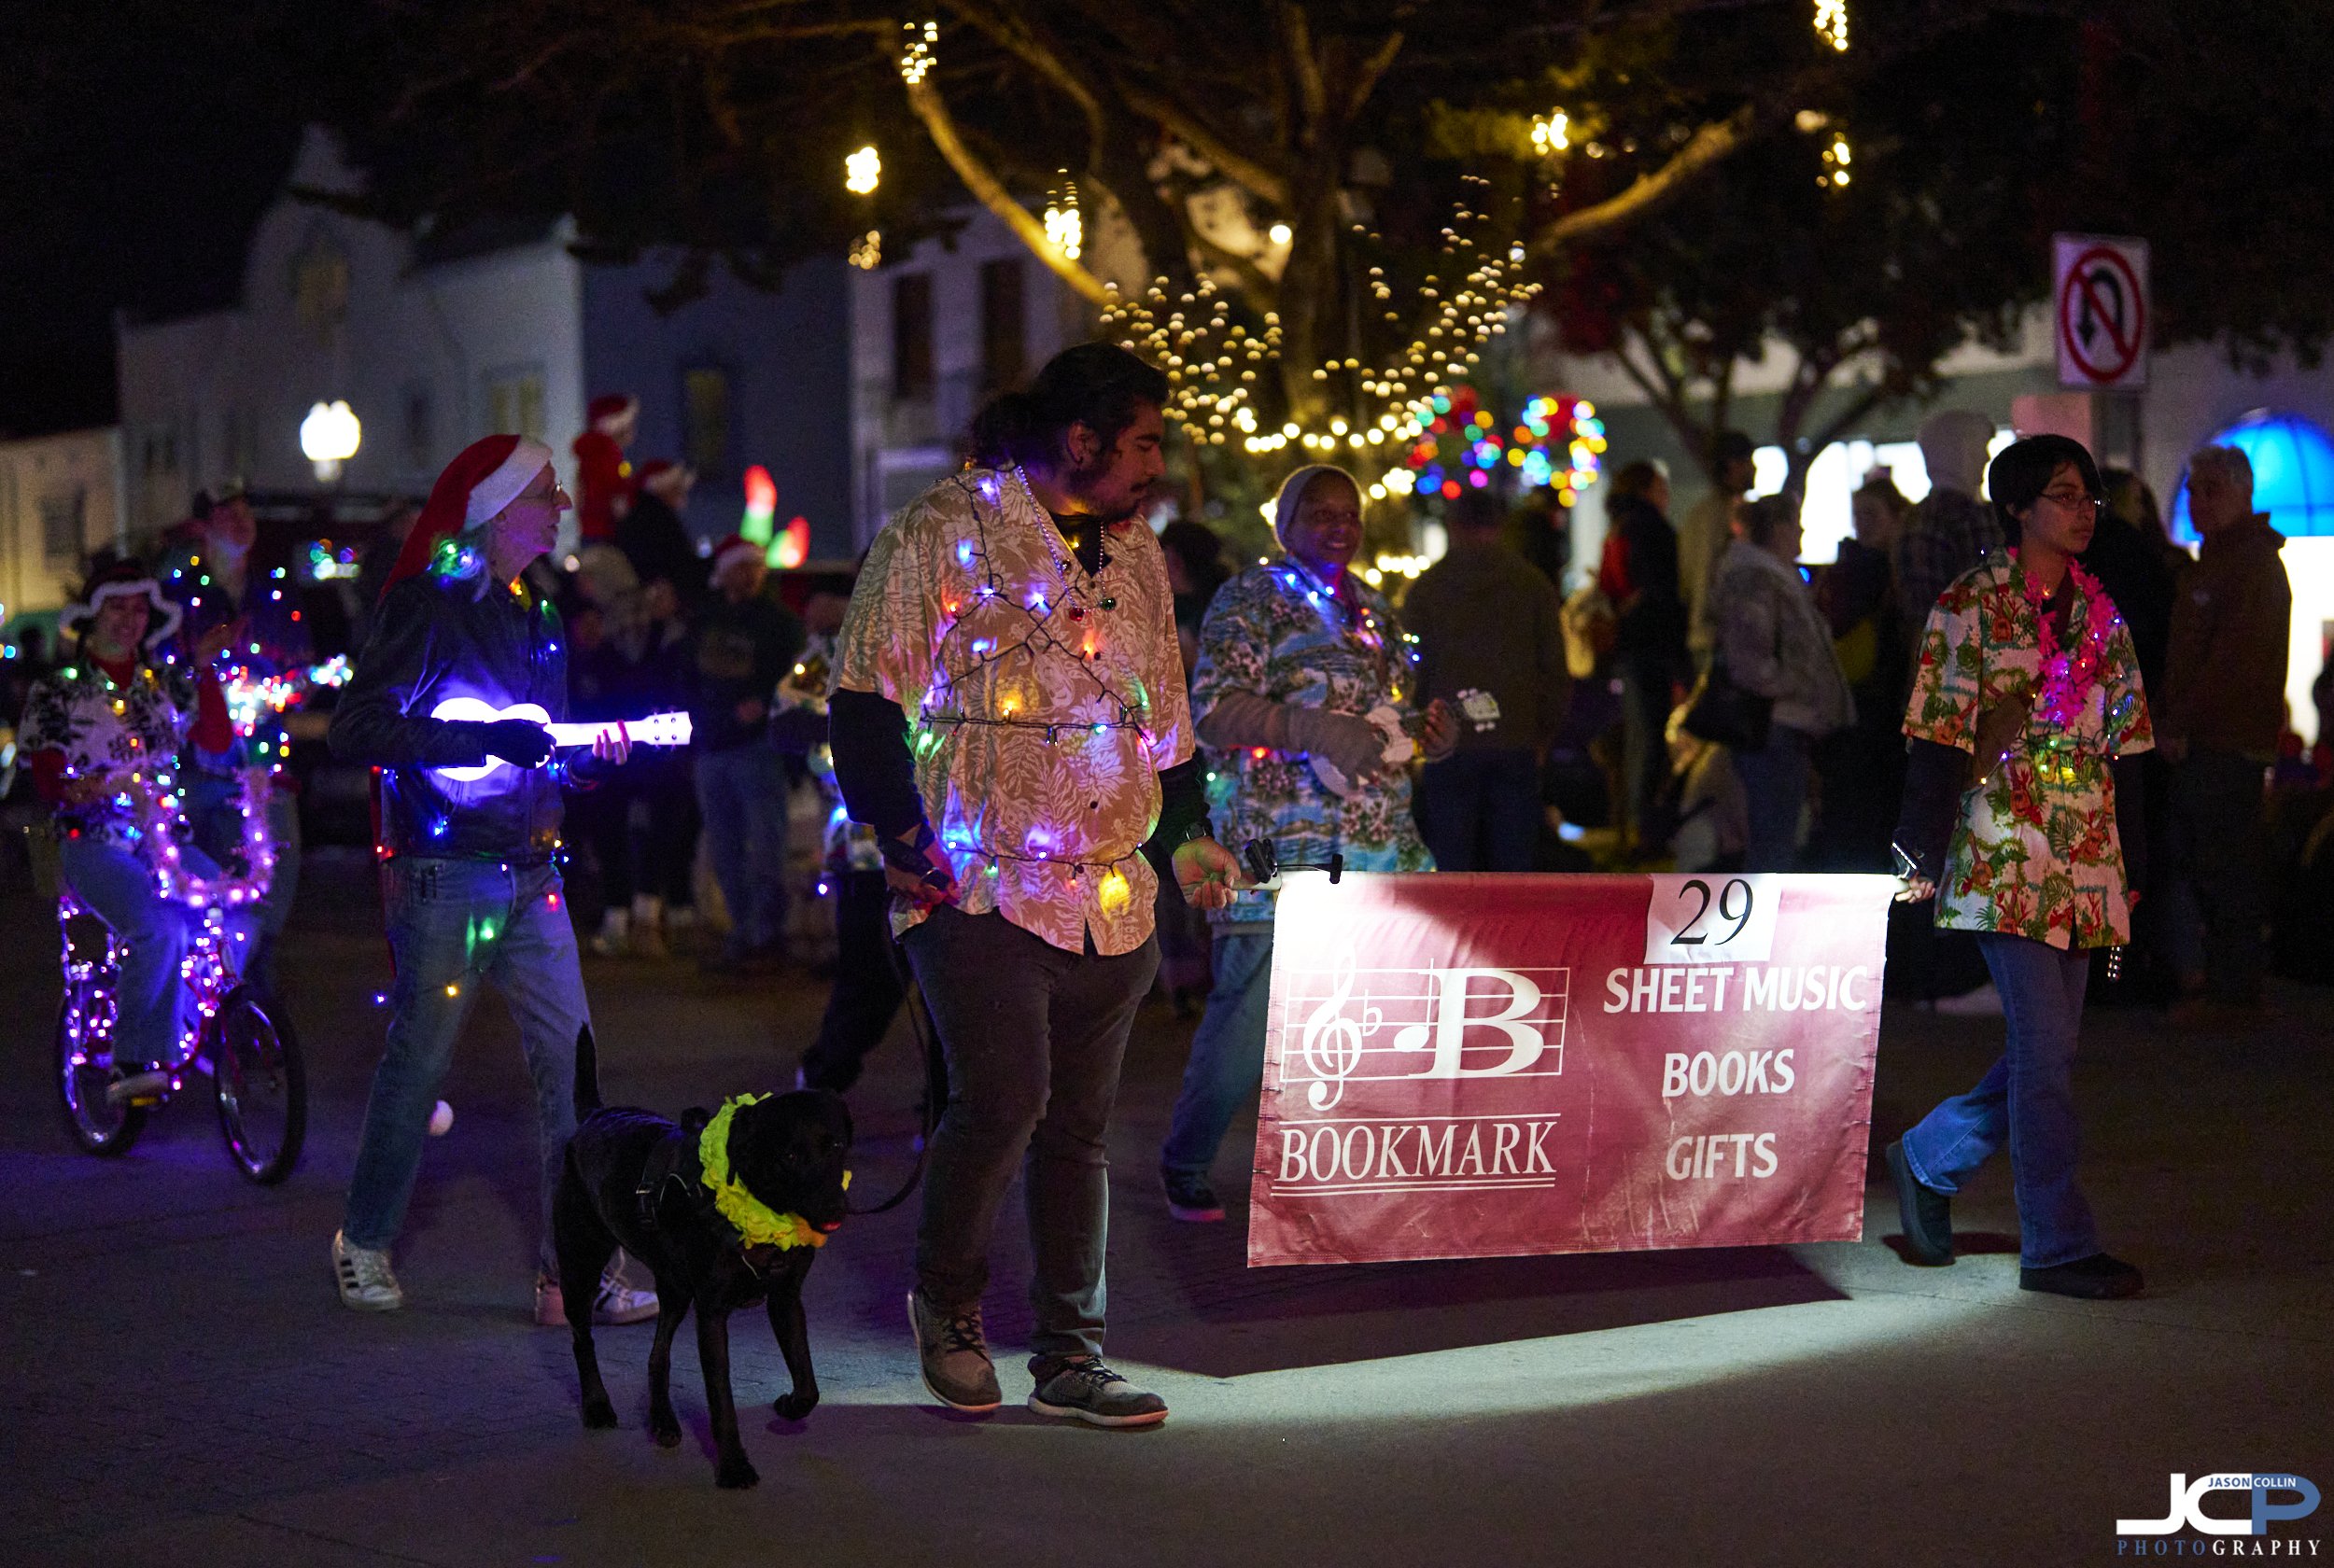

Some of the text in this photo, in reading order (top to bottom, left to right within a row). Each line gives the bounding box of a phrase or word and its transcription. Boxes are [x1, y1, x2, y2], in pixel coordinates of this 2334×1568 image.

[1669, 878, 1754, 946] 29
[1603, 965, 1868, 1014] SHEET MUSIC
[1662, 1048, 1795, 1098] BOOKS
[1273, 1120, 1558, 1183] BOOKMARK
[1666, 1132, 1779, 1181] GIFTS
